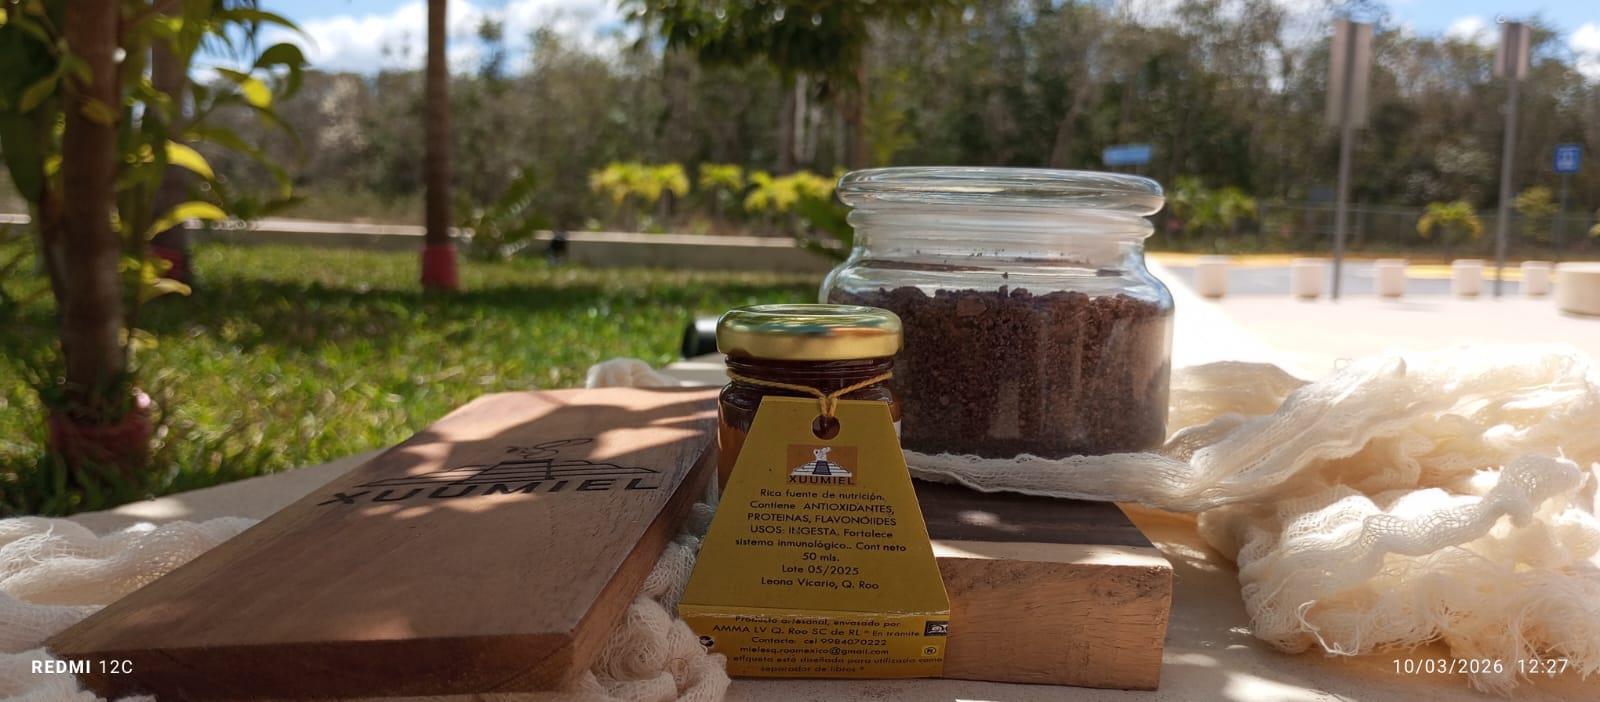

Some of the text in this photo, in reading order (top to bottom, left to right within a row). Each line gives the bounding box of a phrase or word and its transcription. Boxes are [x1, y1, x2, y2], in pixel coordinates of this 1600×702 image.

[789, 475, 855, 485] XUUMIEL
[318, 477, 659, 505] XUUMIEL
[760, 489, 781, 497] Rica
[786, 489, 818, 498] fuente
[822, 490, 835, 499] de
[750, 501, 895, 515] Contiene ANTIOXIDANTES,
[747, 513, 812, 523] PROTEINAS,
[844, 530, 893, 538] Fortalece
[735, 538, 774, 547] sistema
[856, 542, 880, 550] Cont
[802, 553, 839, 562] 50 mls.
[782, 565, 859, 576] Lote 05/2025
[761, 577, 793, 586] Leona
[797, 578, 838, 589] Vicario,
[859, 580, 879, 589] Roo
[713, 624, 750, 633] AMMA
[788, 627, 808, 635] Roo
[812, 628, 827, 636] SC
[831, 628, 845, 636] de
